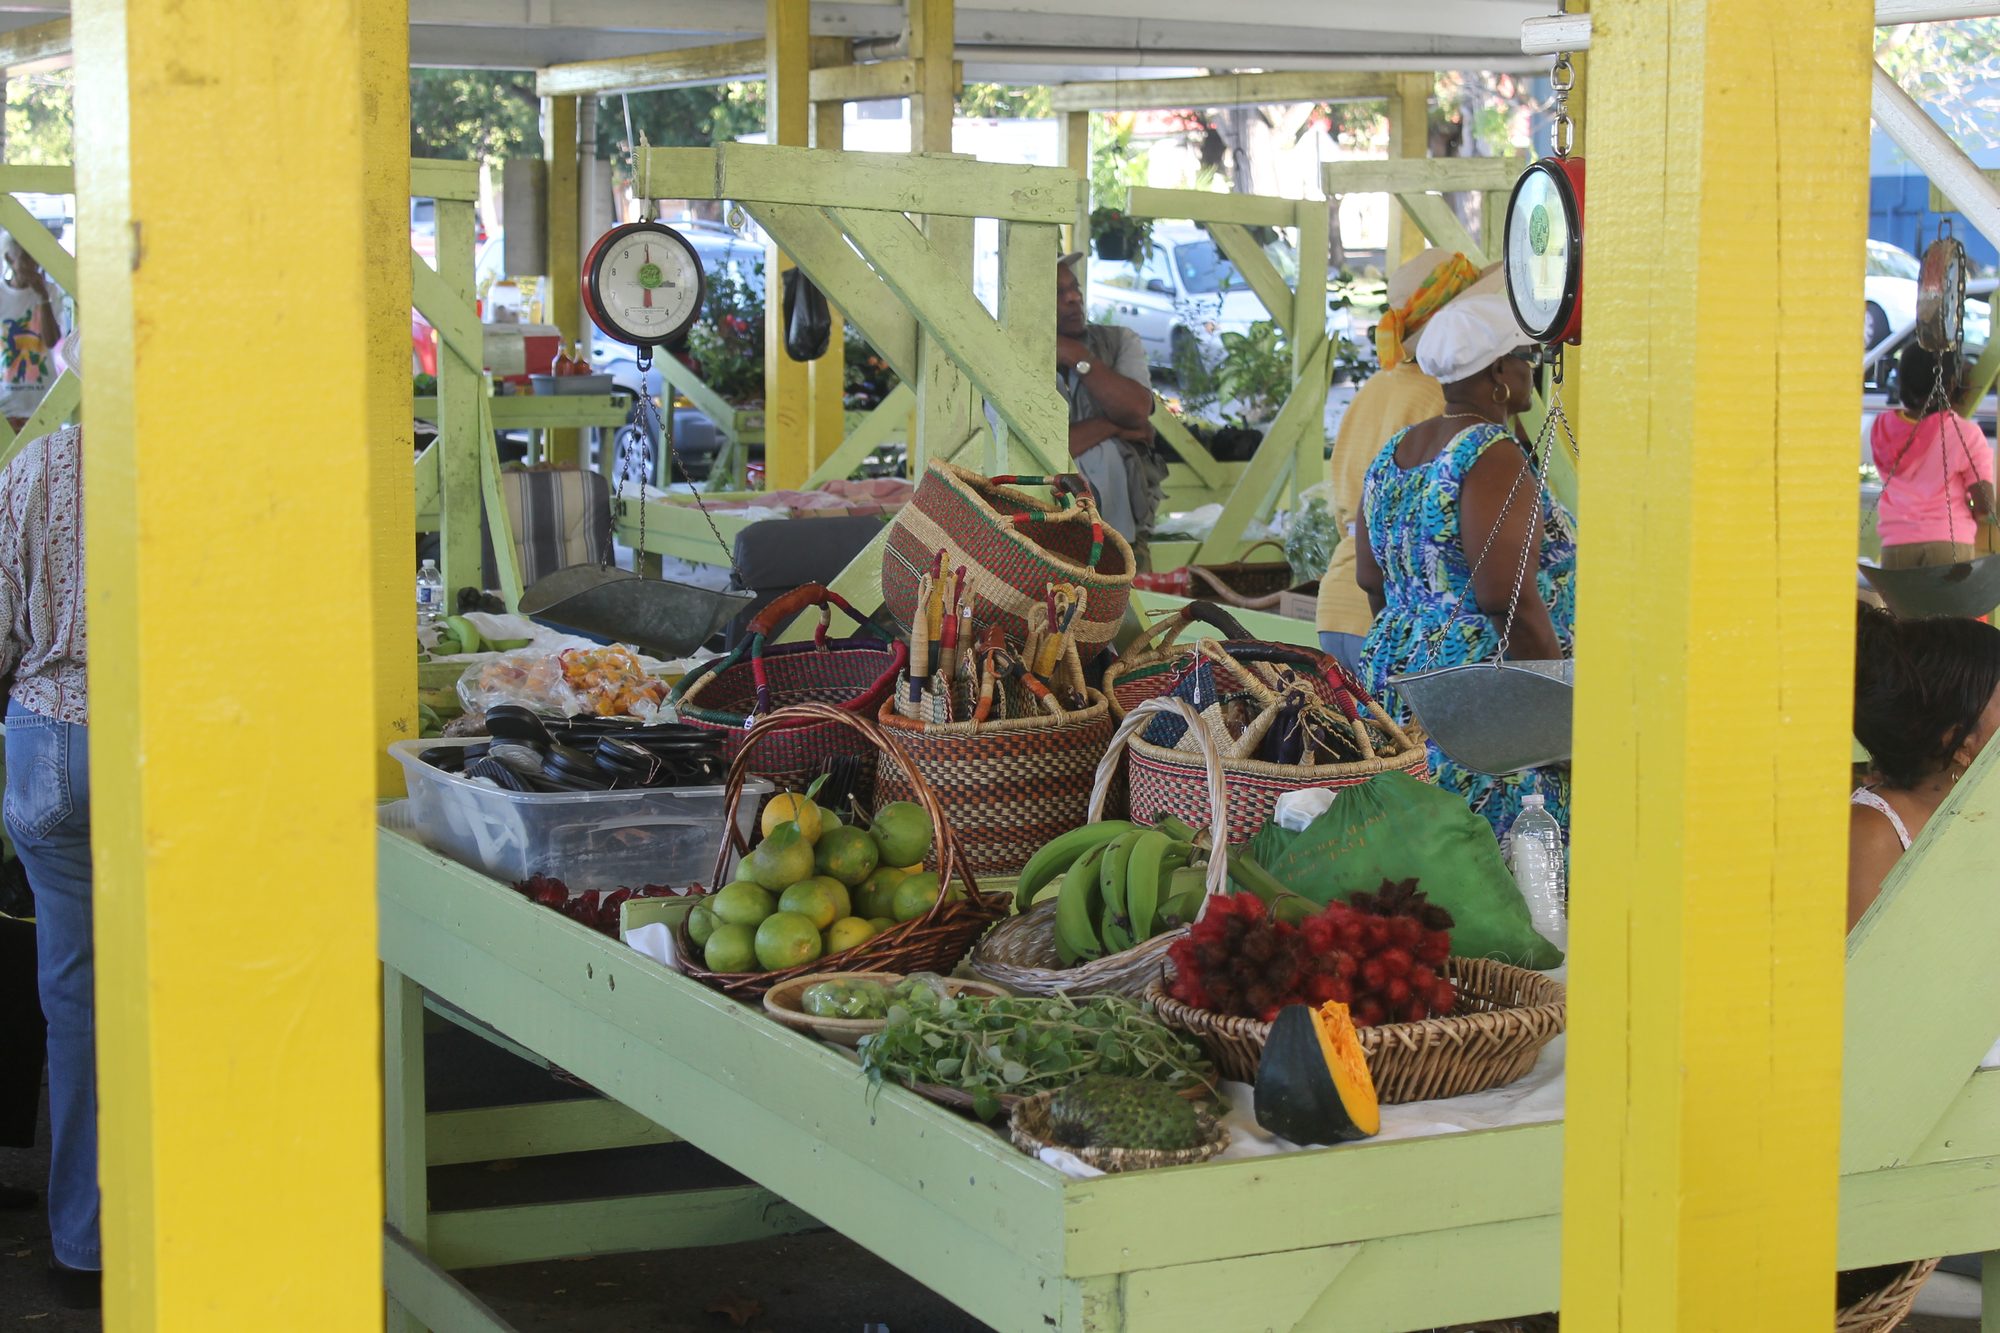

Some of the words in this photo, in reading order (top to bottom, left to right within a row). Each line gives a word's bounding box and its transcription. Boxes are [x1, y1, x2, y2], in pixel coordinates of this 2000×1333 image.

[624, 250, 629, 259] 9
[611, 268, 616, 276] 8
[677, 268, 682, 277] 2
[611, 291, 616, 300] 7
[677, 291, 682, 300] 3
[624, 308, 630, 317] 6
[664, 308, 669, 317] 4
[645, 315, 650, 324] 5
